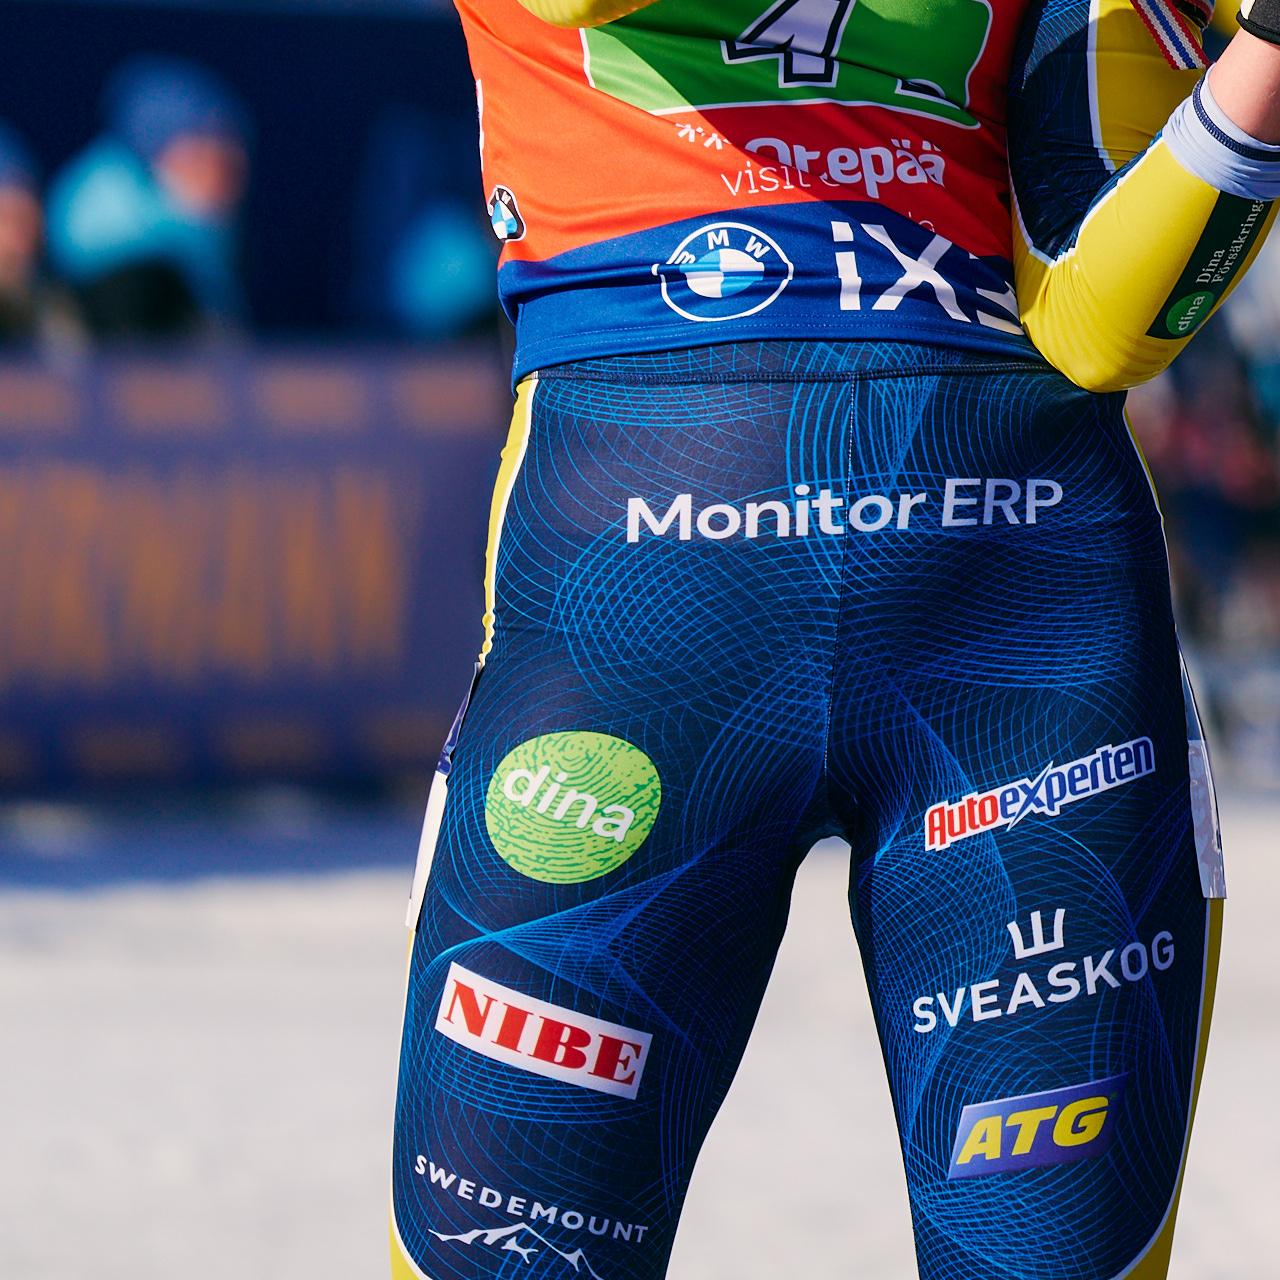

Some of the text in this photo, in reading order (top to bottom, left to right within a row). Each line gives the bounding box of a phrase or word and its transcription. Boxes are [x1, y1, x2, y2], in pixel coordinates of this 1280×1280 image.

[1195, 249, 1226, 284] Dina
[1177, 294, 1206, 332] dina
[626, 477, 1064, 543] Monitor ERP
[503, 764, 636, 844] dina
[927, 737, 1154, 848] Autoexperten
[912, 929, 1176, 1034] SVEASKOG
[442, 979, 643, 1087] NIBE
[956, 1094, 1112, 1166] ATG
[414, 1154, 649, 1245] SWEDEMOUNT
